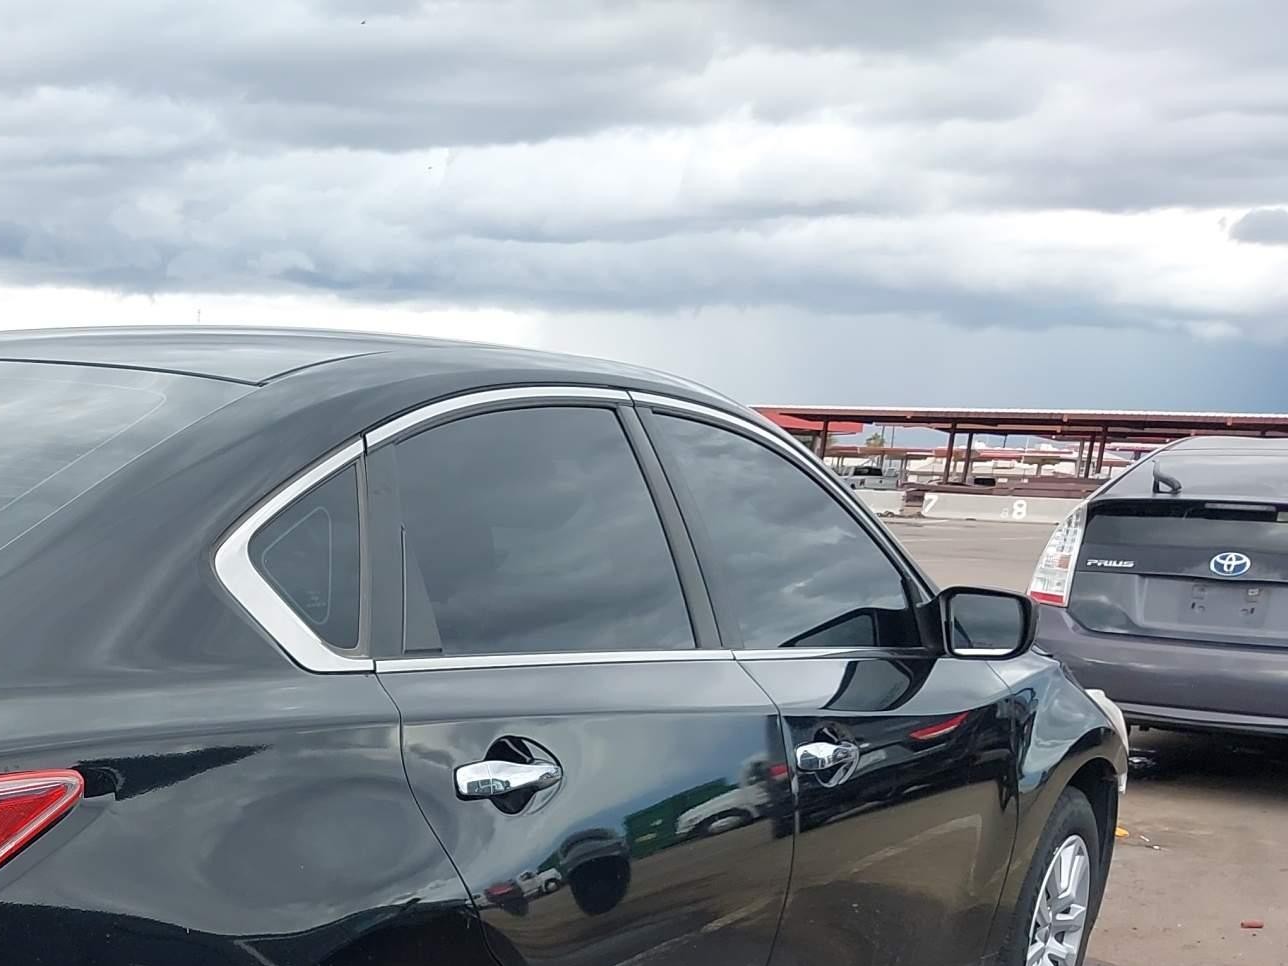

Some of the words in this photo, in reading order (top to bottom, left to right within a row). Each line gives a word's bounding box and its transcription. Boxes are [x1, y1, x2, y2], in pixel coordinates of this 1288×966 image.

[922, 493, 939, 514] 7
[1012, 499, 1028, 520] 8
[1086, 559, 1135, 568] PRIUS
